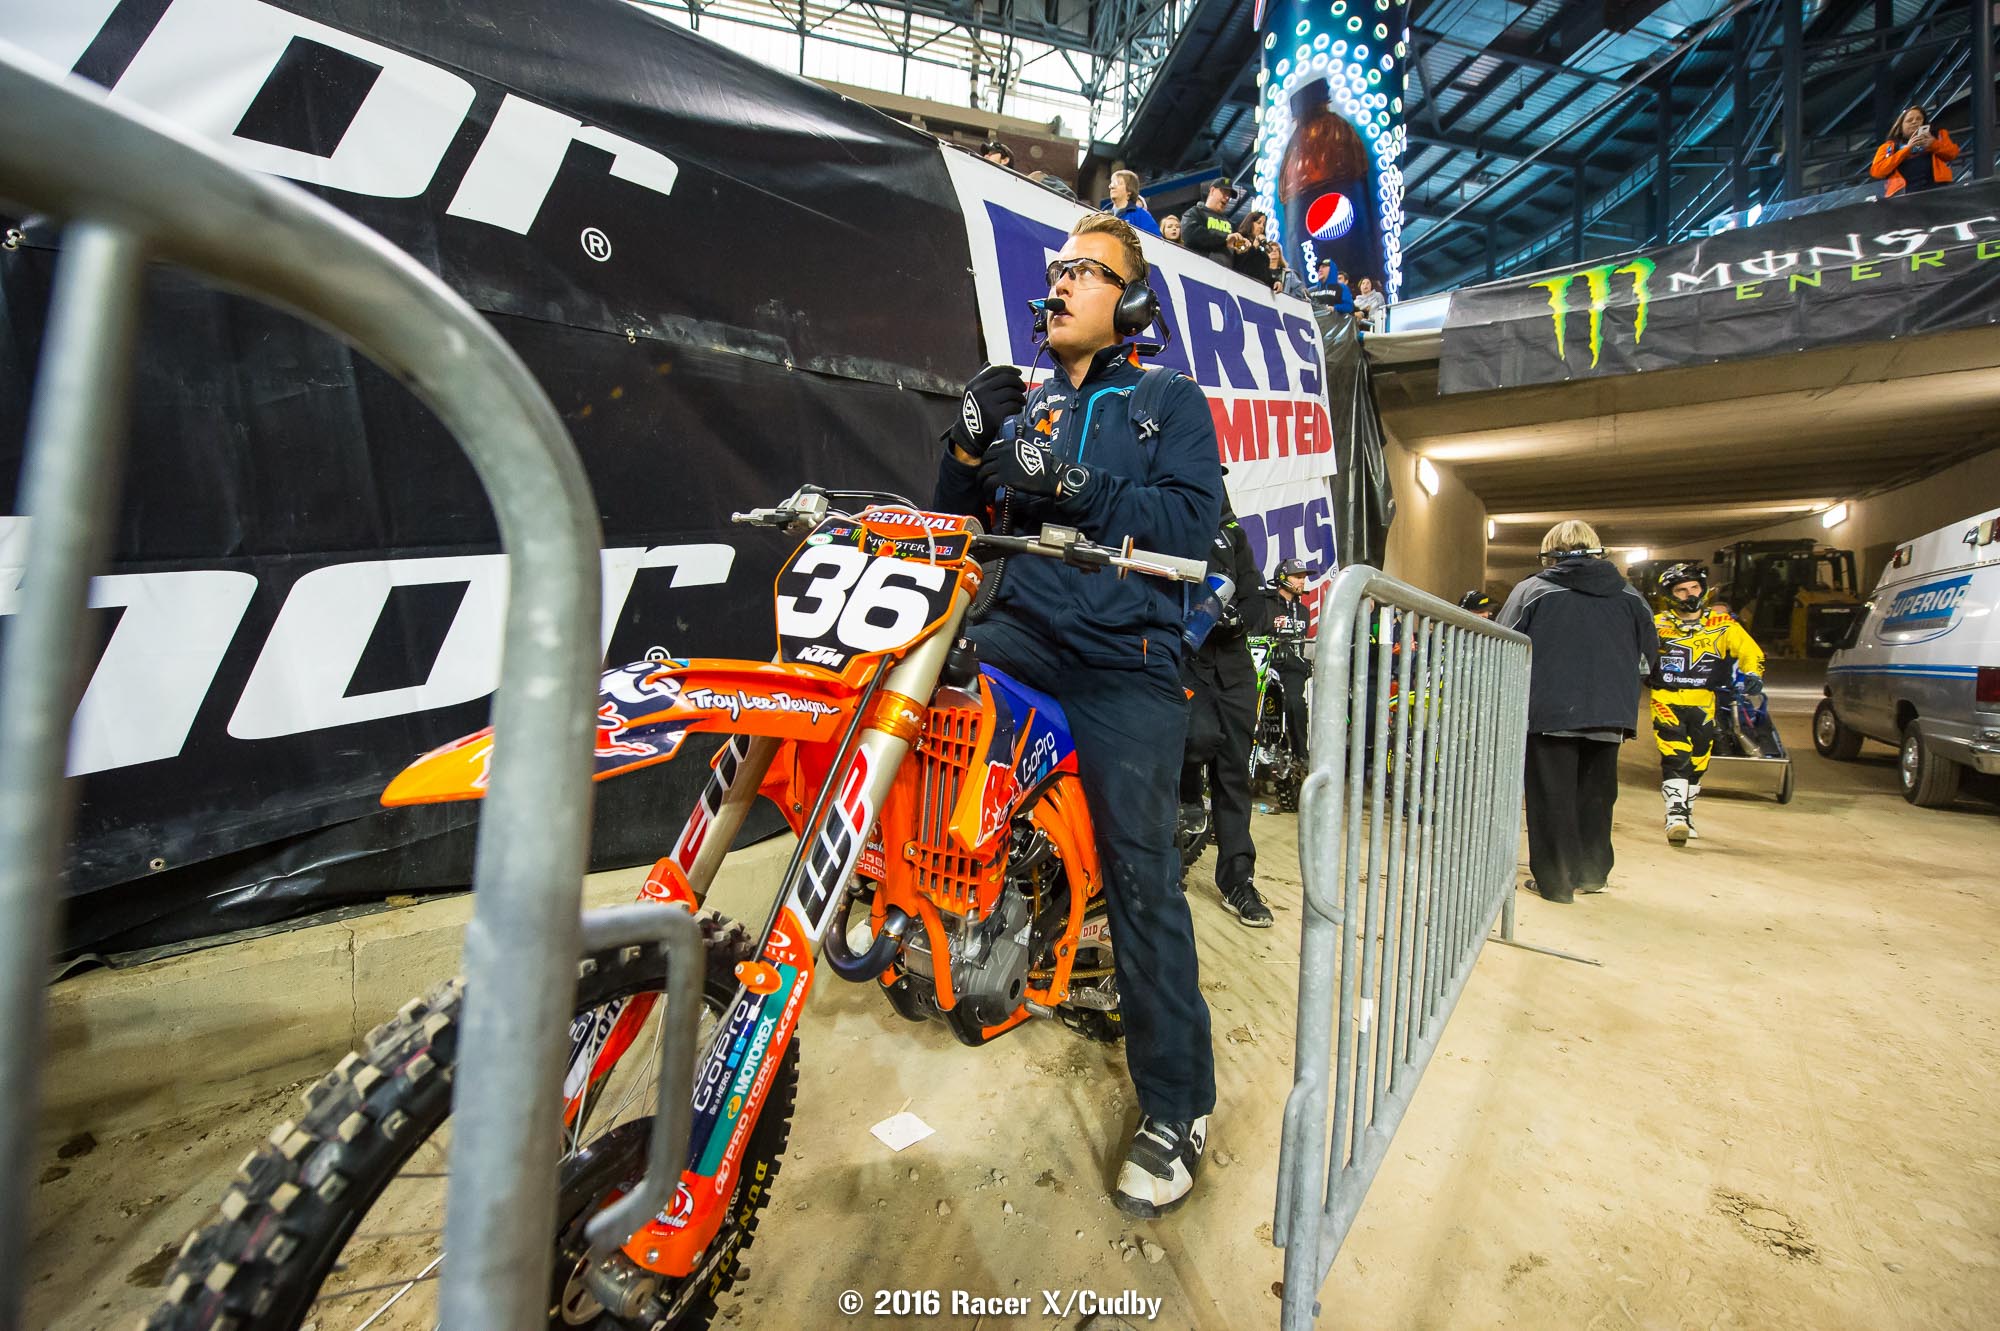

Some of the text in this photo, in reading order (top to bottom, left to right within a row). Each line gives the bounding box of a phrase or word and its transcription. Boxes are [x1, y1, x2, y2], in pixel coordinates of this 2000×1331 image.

[866, 510, 957, 532] RENTHAL
[777, 544, 946, 653] 36
[1884, 583, 1971, 618] SUPERIOR
[796, 644, 846, 667] KTM
[688, 689, 840, 723] Troy Lee Designs
[1021, 731, 1055, 783] GoPro
[1083, 924, 1098, 938] DID
[775, 969, 808, 1046] ACERBIS
[693, 999, 749, 1112] GoPro
[733, 1015, 777, 1095] MOTOREX
[726, 1113, 749, 1159] PRO
[745, 1053, 775, 1109] TORK
